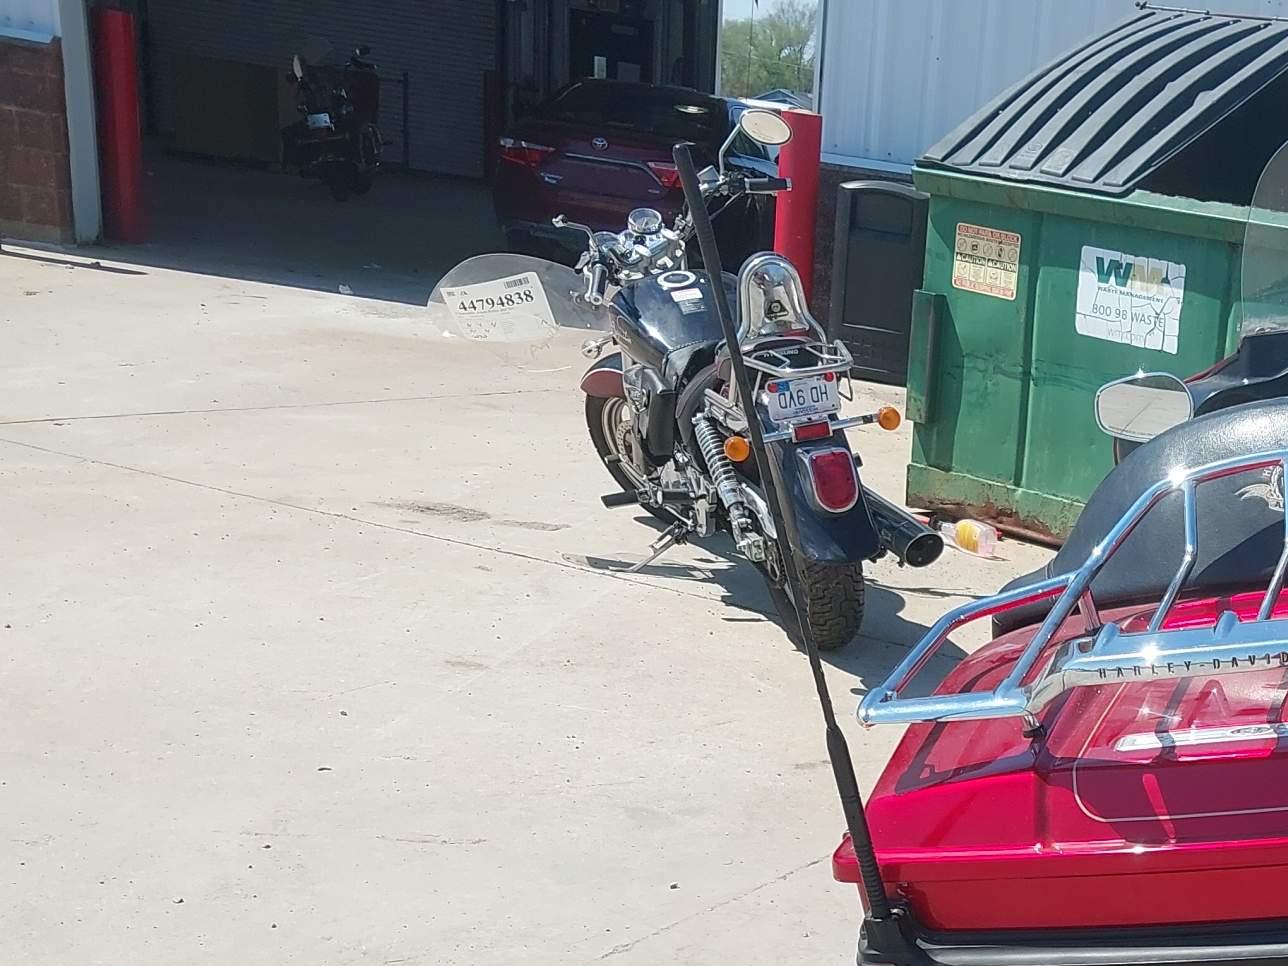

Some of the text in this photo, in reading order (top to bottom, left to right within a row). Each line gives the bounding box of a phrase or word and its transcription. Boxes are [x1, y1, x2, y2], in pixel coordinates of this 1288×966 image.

[962, 253, 986, 266] CAUTION
[993, 260, 1017, 272] CAUTION
[458, 289, 534, 312] 44794838
[1092, 304, 1112, 317] 800
